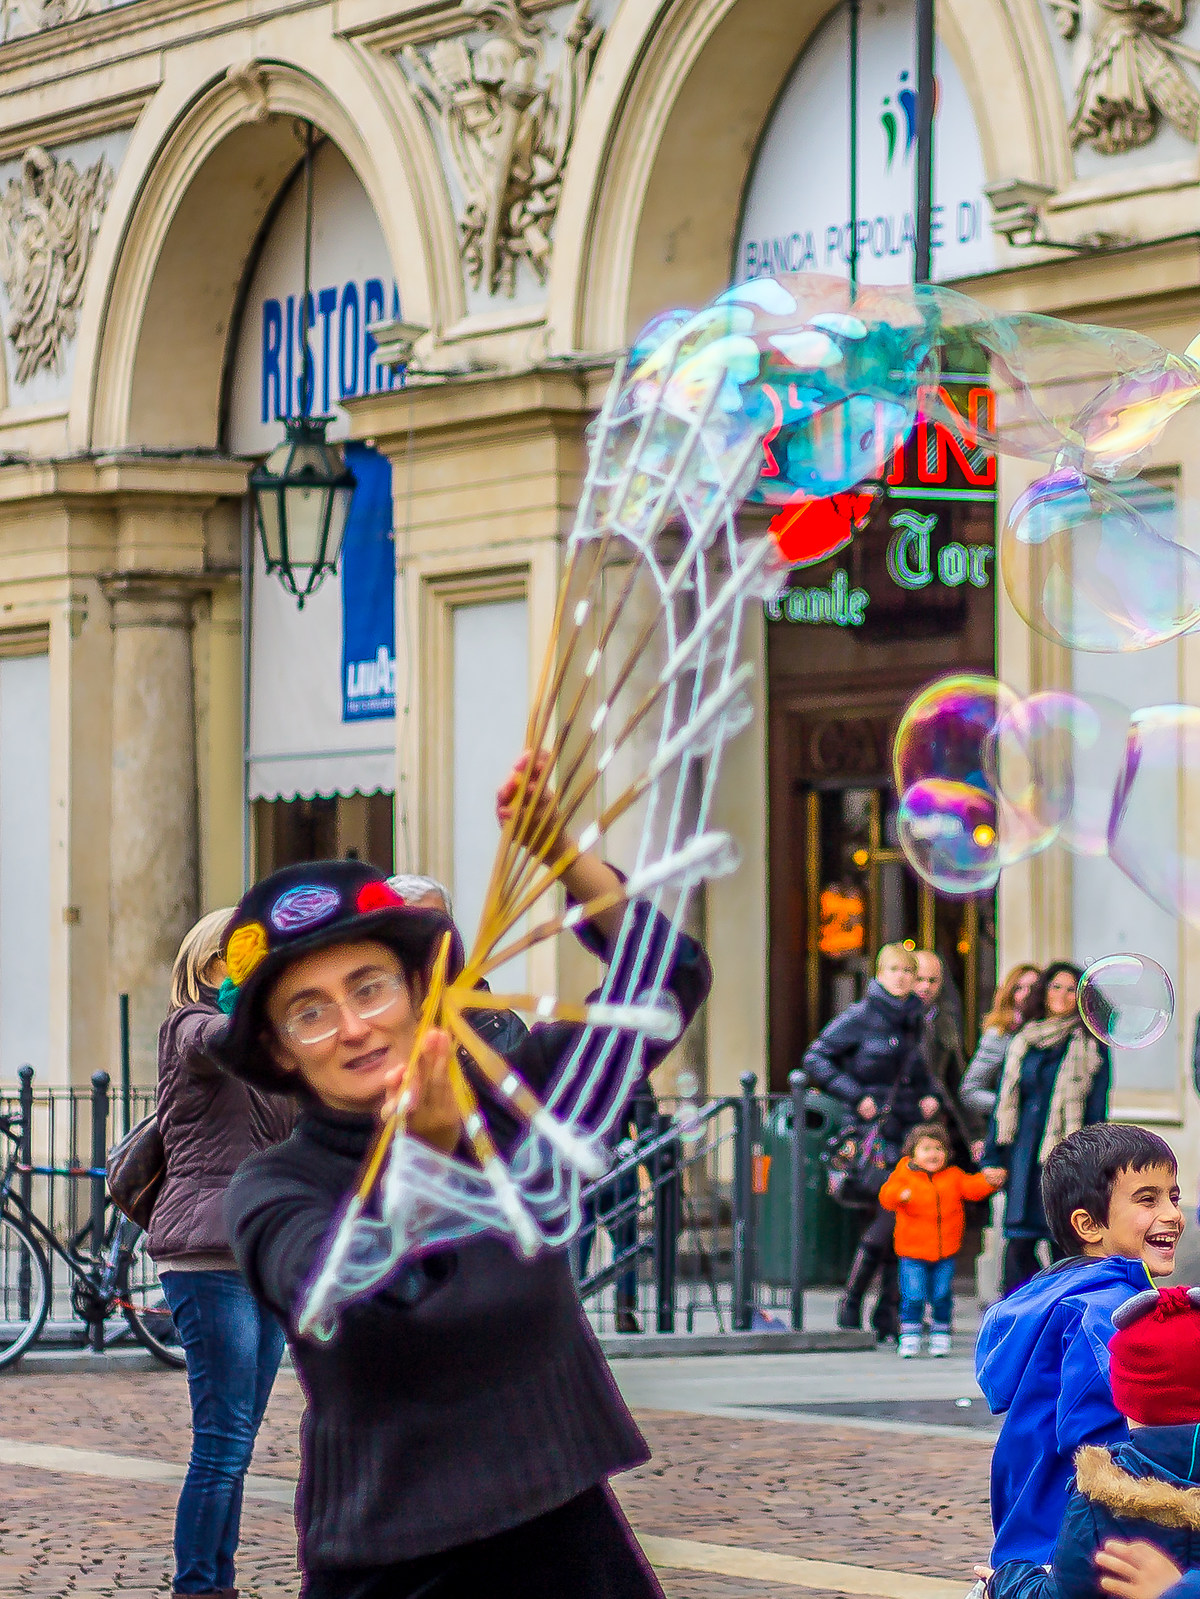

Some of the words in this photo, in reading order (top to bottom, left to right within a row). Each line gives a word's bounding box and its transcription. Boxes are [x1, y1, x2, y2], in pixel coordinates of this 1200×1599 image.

[746, 231, 818, 280] BANCA
[825, 203, 944, 268] POPOLAE
[956, 200, 984, 244] DI
